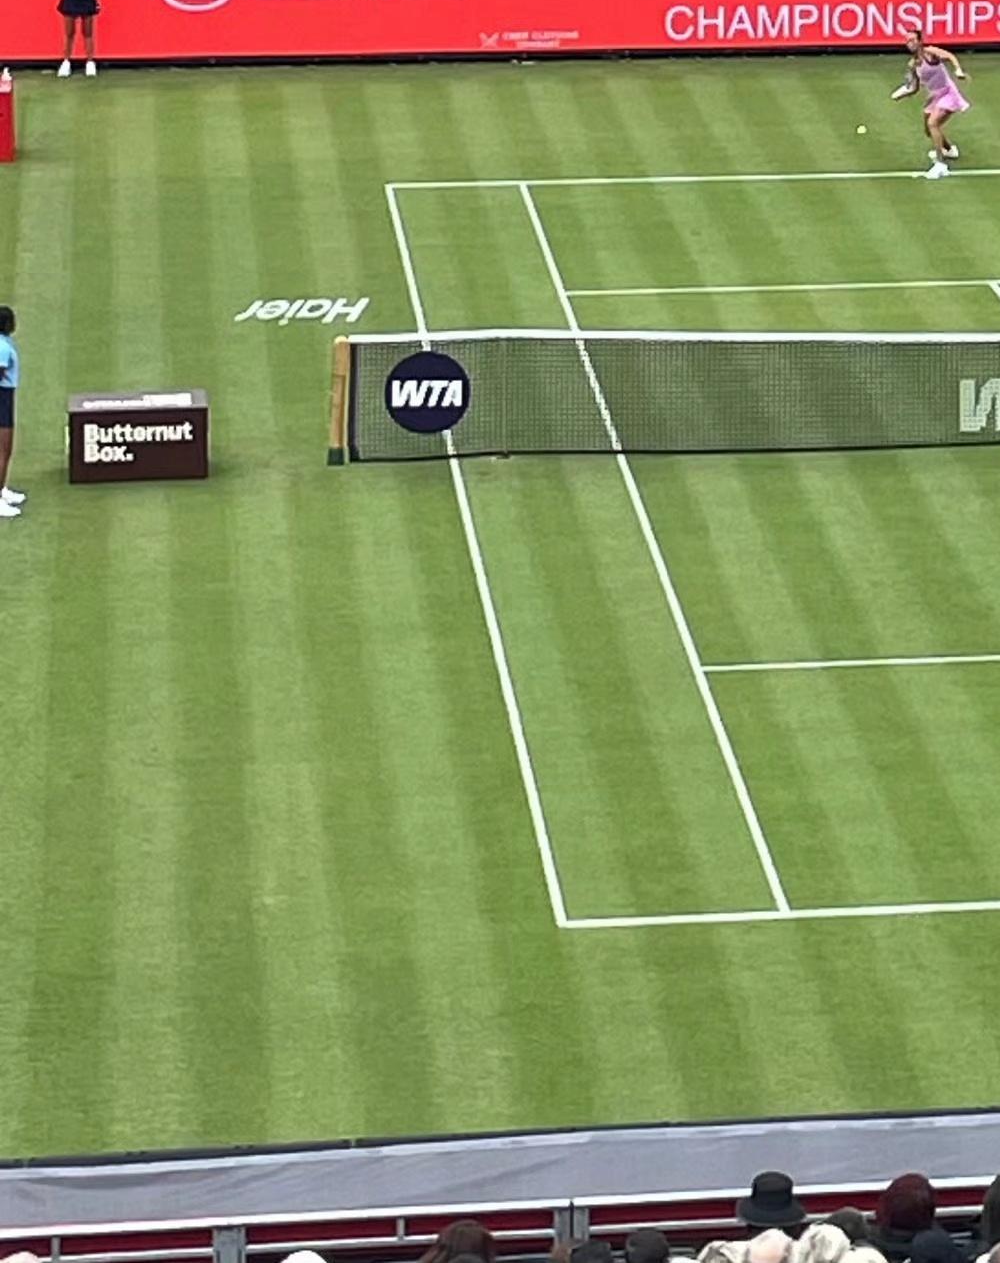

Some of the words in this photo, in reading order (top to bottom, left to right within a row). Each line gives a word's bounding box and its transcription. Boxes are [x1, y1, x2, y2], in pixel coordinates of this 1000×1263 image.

[234, 296, 370, 326] Haier
[391, 379, 463, 408] WTA
[83, 421, 194, 444] Butternut
[83, 443, 134, 463] Box.
